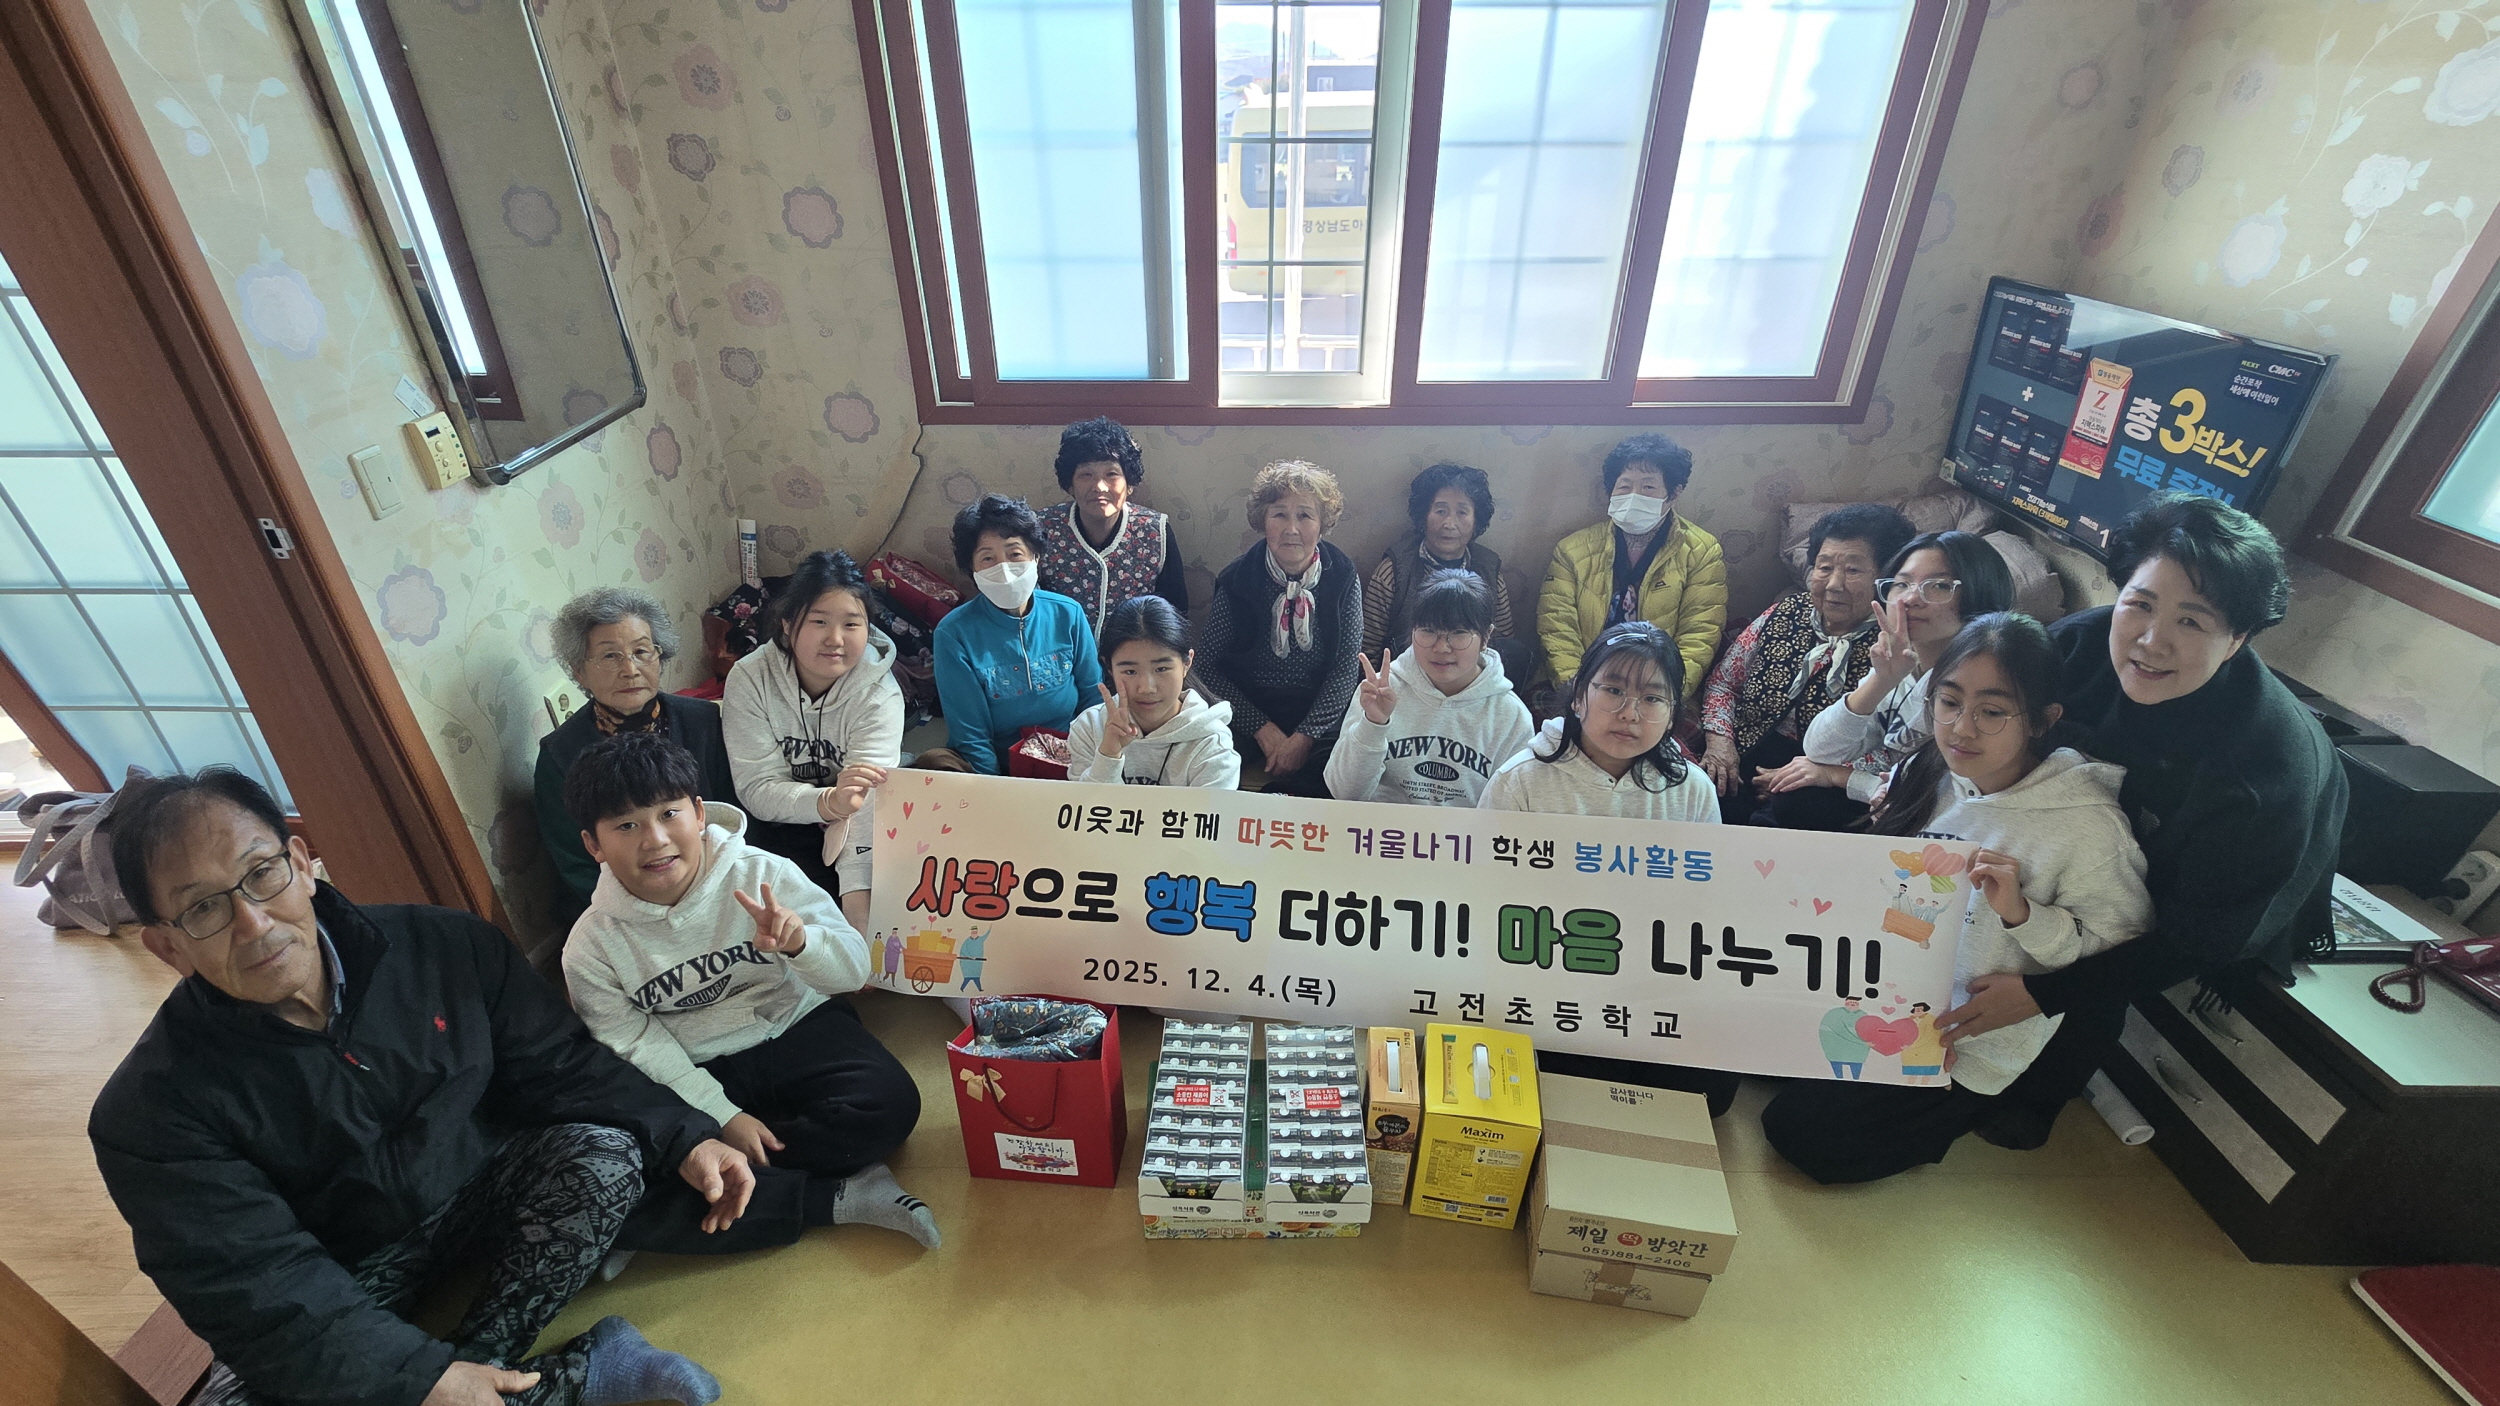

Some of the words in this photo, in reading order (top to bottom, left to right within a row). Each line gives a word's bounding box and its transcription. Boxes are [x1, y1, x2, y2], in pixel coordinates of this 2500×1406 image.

[2229, 384, 2251, 398] 세상에
[2233, 374, 2263, 389] 순간포착
[2093, 389, 2110, 411] Z
[2124, 397, 2162, 442] 총
[2159, 388, 2268, 478] 3박스!
[2113, 445, 2167, 490] 무료
[1383, 736, 1437, 761] NEW
[1437, 736, 1492, 779] YORK
[1418, 763, 1457, 780] COLUMBIA
[1058, 804, 1144, 837] 이웃과
[1162, 809, 1219, 841] 함께
[1239, 818, 1328, 852] 따뜻한
[1347, 827, 1472, 864] 겨울나기
[1492, 835, 1555, 869] 학생
[1575, 842, 1713, 882] 봉사활동
[906, 856, 1119, 922] 사랑으로
[1144, 872, 1256, 942] 행복
[1279, 890, 1469, 957] 더하기!
[1498, 904, 1623, 976] 마음
[1652, 920, 1882, 1001] 나누기!
[686, 941, 774, 984] YORK
[1084, 958, 1168, 987] 2025.
[1188, 967, 1230, 993] 12.
[680, 977, 729, 1007] COLUMBIA
[1609, 1086, 1654, 1100] 감사합니다
[1460, 1126, 1505, 1140] Maxim
[1567, 1225, 1609, 1245] 제일
[1622, 1232, 1639, 1245] 떡
[1648, 1237, 1709, 1258] 방앗간
[1582, 1246, 1692, 1268] 055)884-2406
